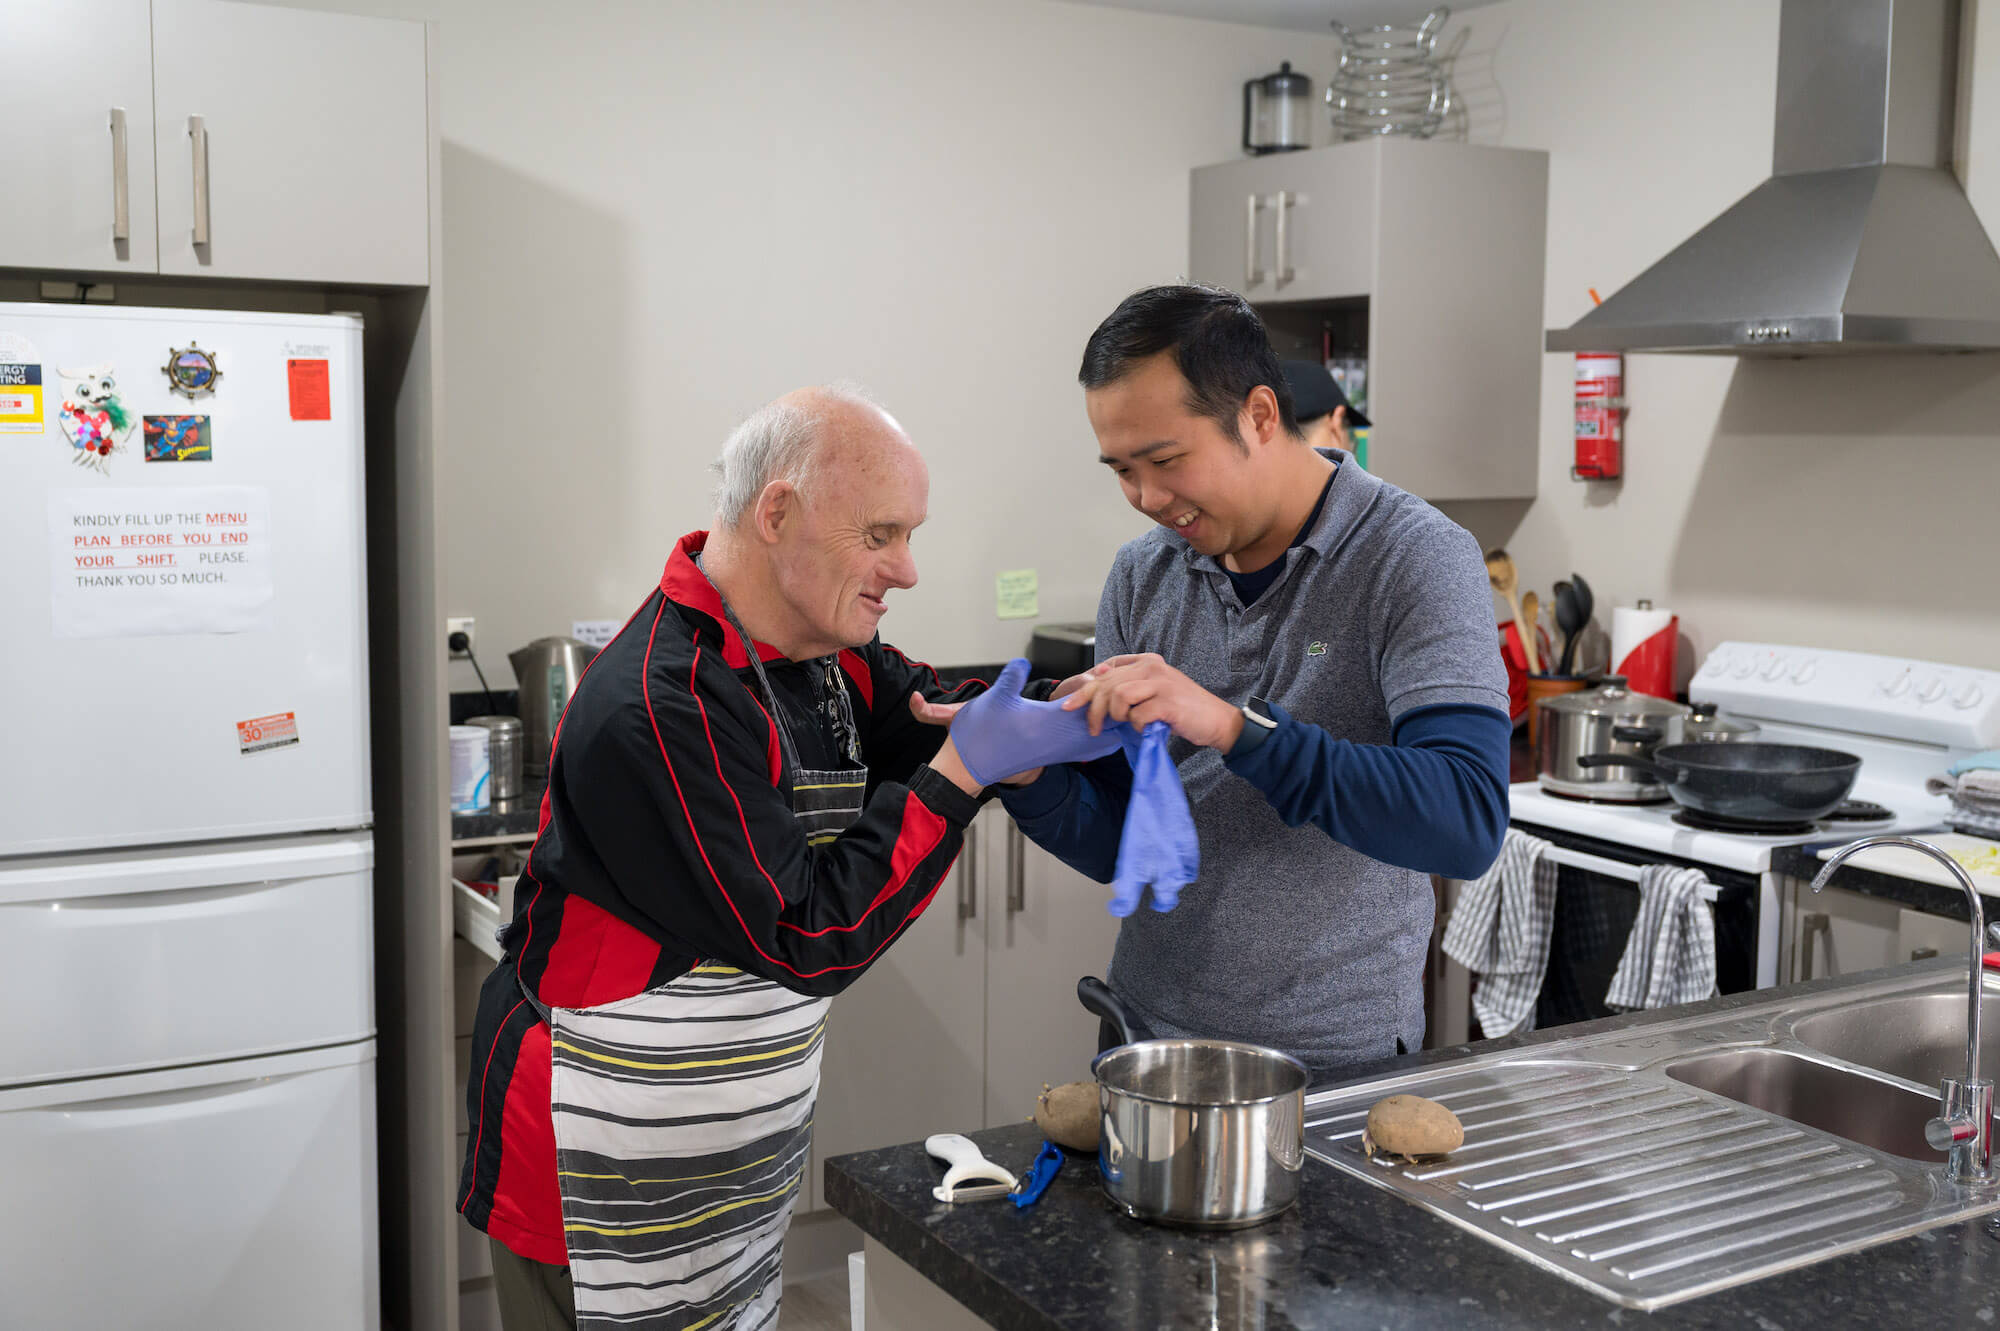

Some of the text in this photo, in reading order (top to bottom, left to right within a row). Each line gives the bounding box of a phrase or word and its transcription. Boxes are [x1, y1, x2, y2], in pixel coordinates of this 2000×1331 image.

[73, 512, 248, 527] KINDLY FILL UP THE MENU
[74, 532, 249, 547] PLAN BEFORE YOU END
[75, 551, 249, 567] YOUR SHIFT. PLEASE.
[76, 572, 228, 588] THANK YOU SO MUCH.
[243, 727, 262, 743] 30
